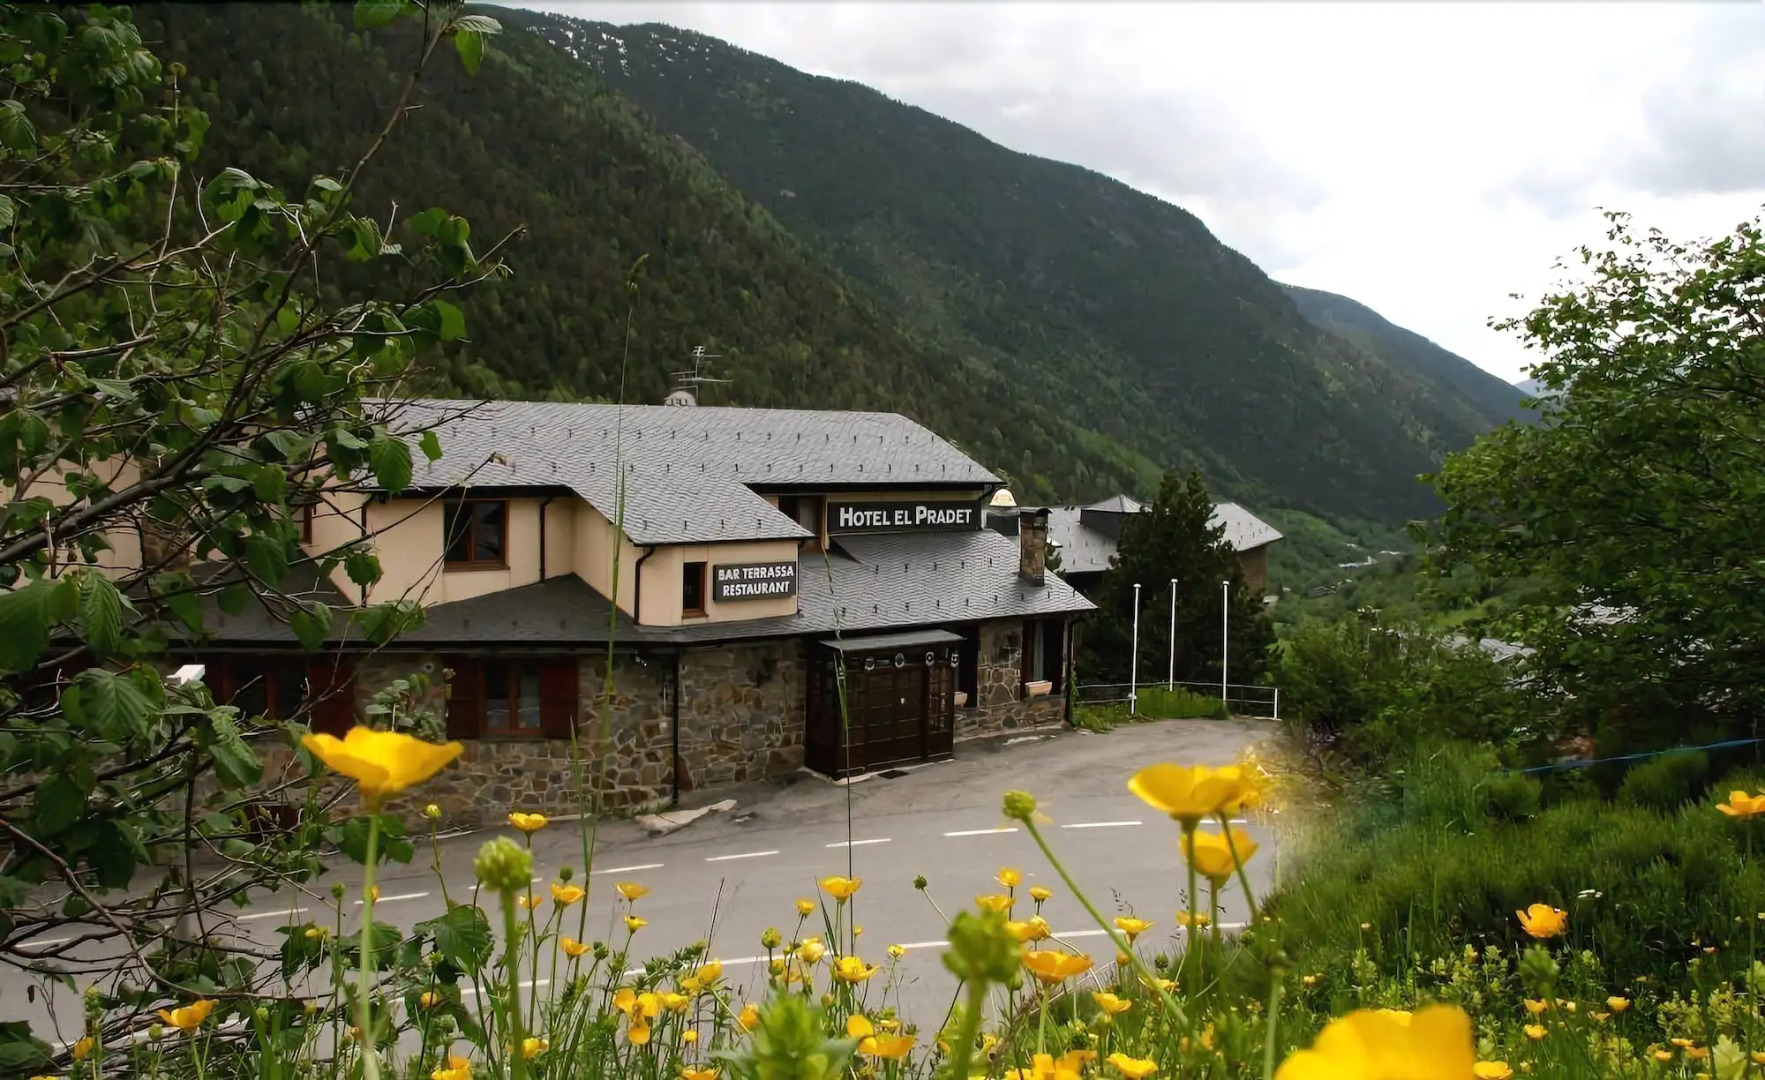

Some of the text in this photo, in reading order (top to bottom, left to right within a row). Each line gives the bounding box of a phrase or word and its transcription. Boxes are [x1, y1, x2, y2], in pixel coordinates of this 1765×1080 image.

[840, 505, 972, 527] HOTEL EL PRADET
[719, 566, 794, 580] BAR TERRASSA
[723, 581, 790, 596] RESTAURANT
